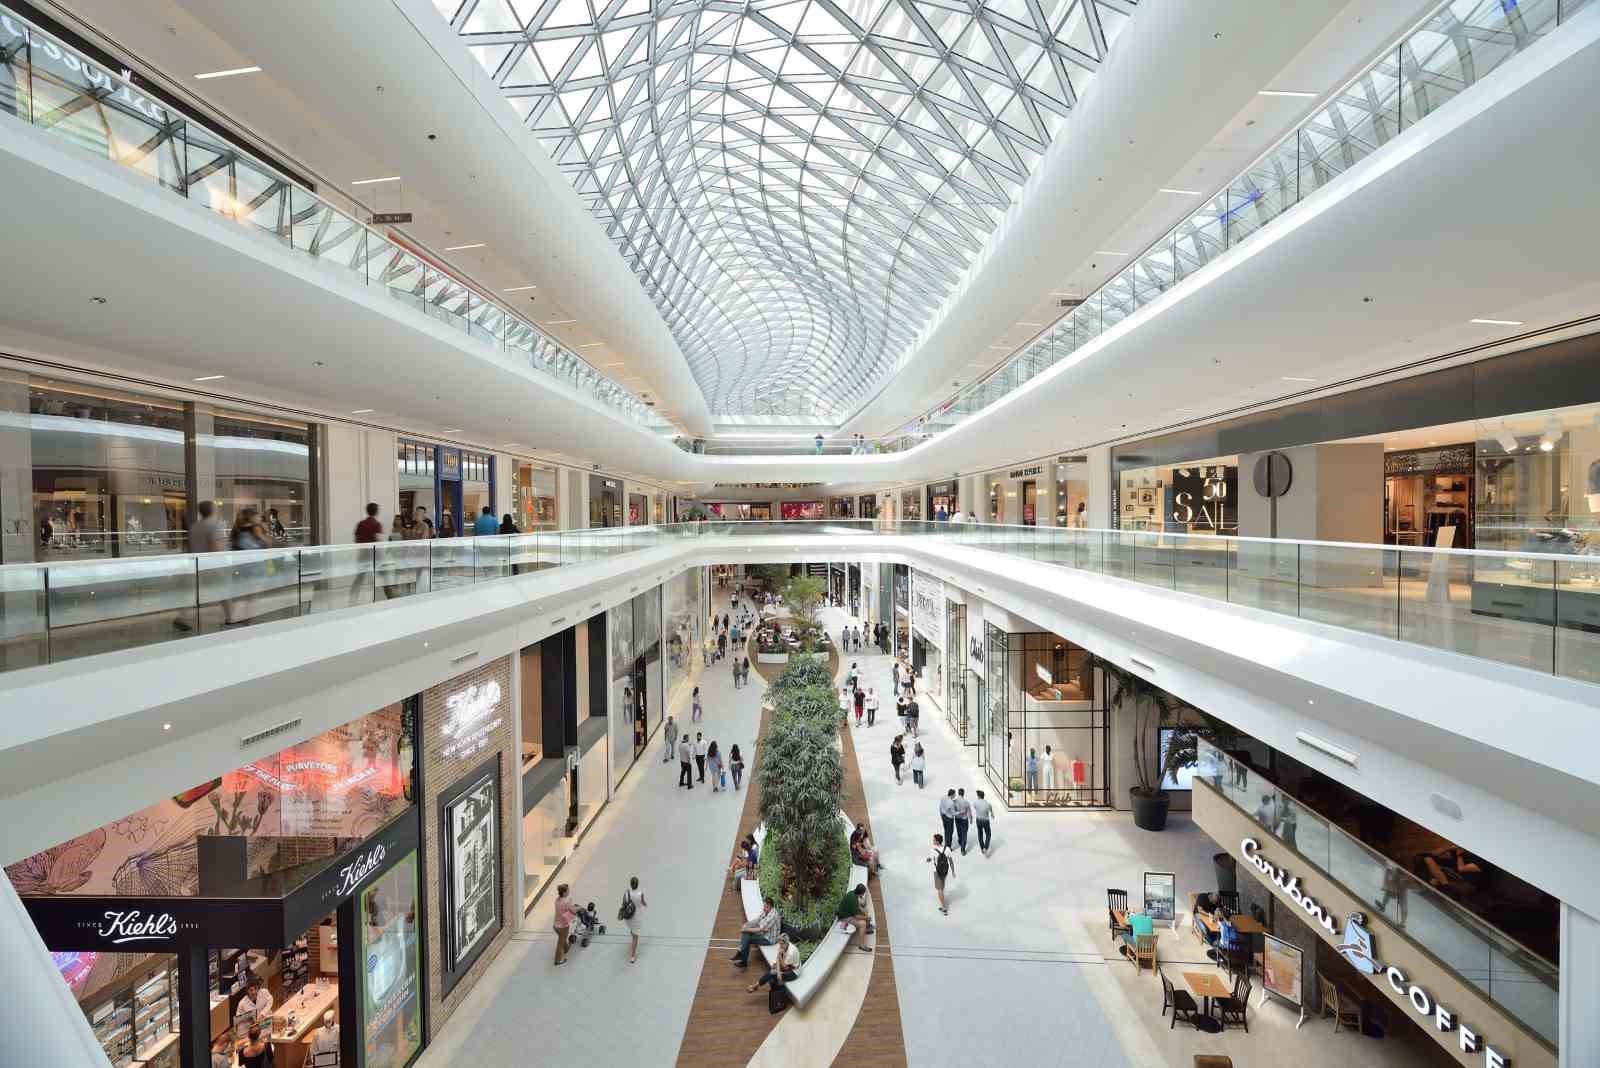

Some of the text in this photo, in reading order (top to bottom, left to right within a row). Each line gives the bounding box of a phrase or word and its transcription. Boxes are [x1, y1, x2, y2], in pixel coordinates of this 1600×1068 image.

[1203, 477, 1227, 500] 50
[336, 844, 386, 896] Kiehl's
[1240, 838, 1338, 935] Caribou
[98, 910, 178, 943] Kiehl's
